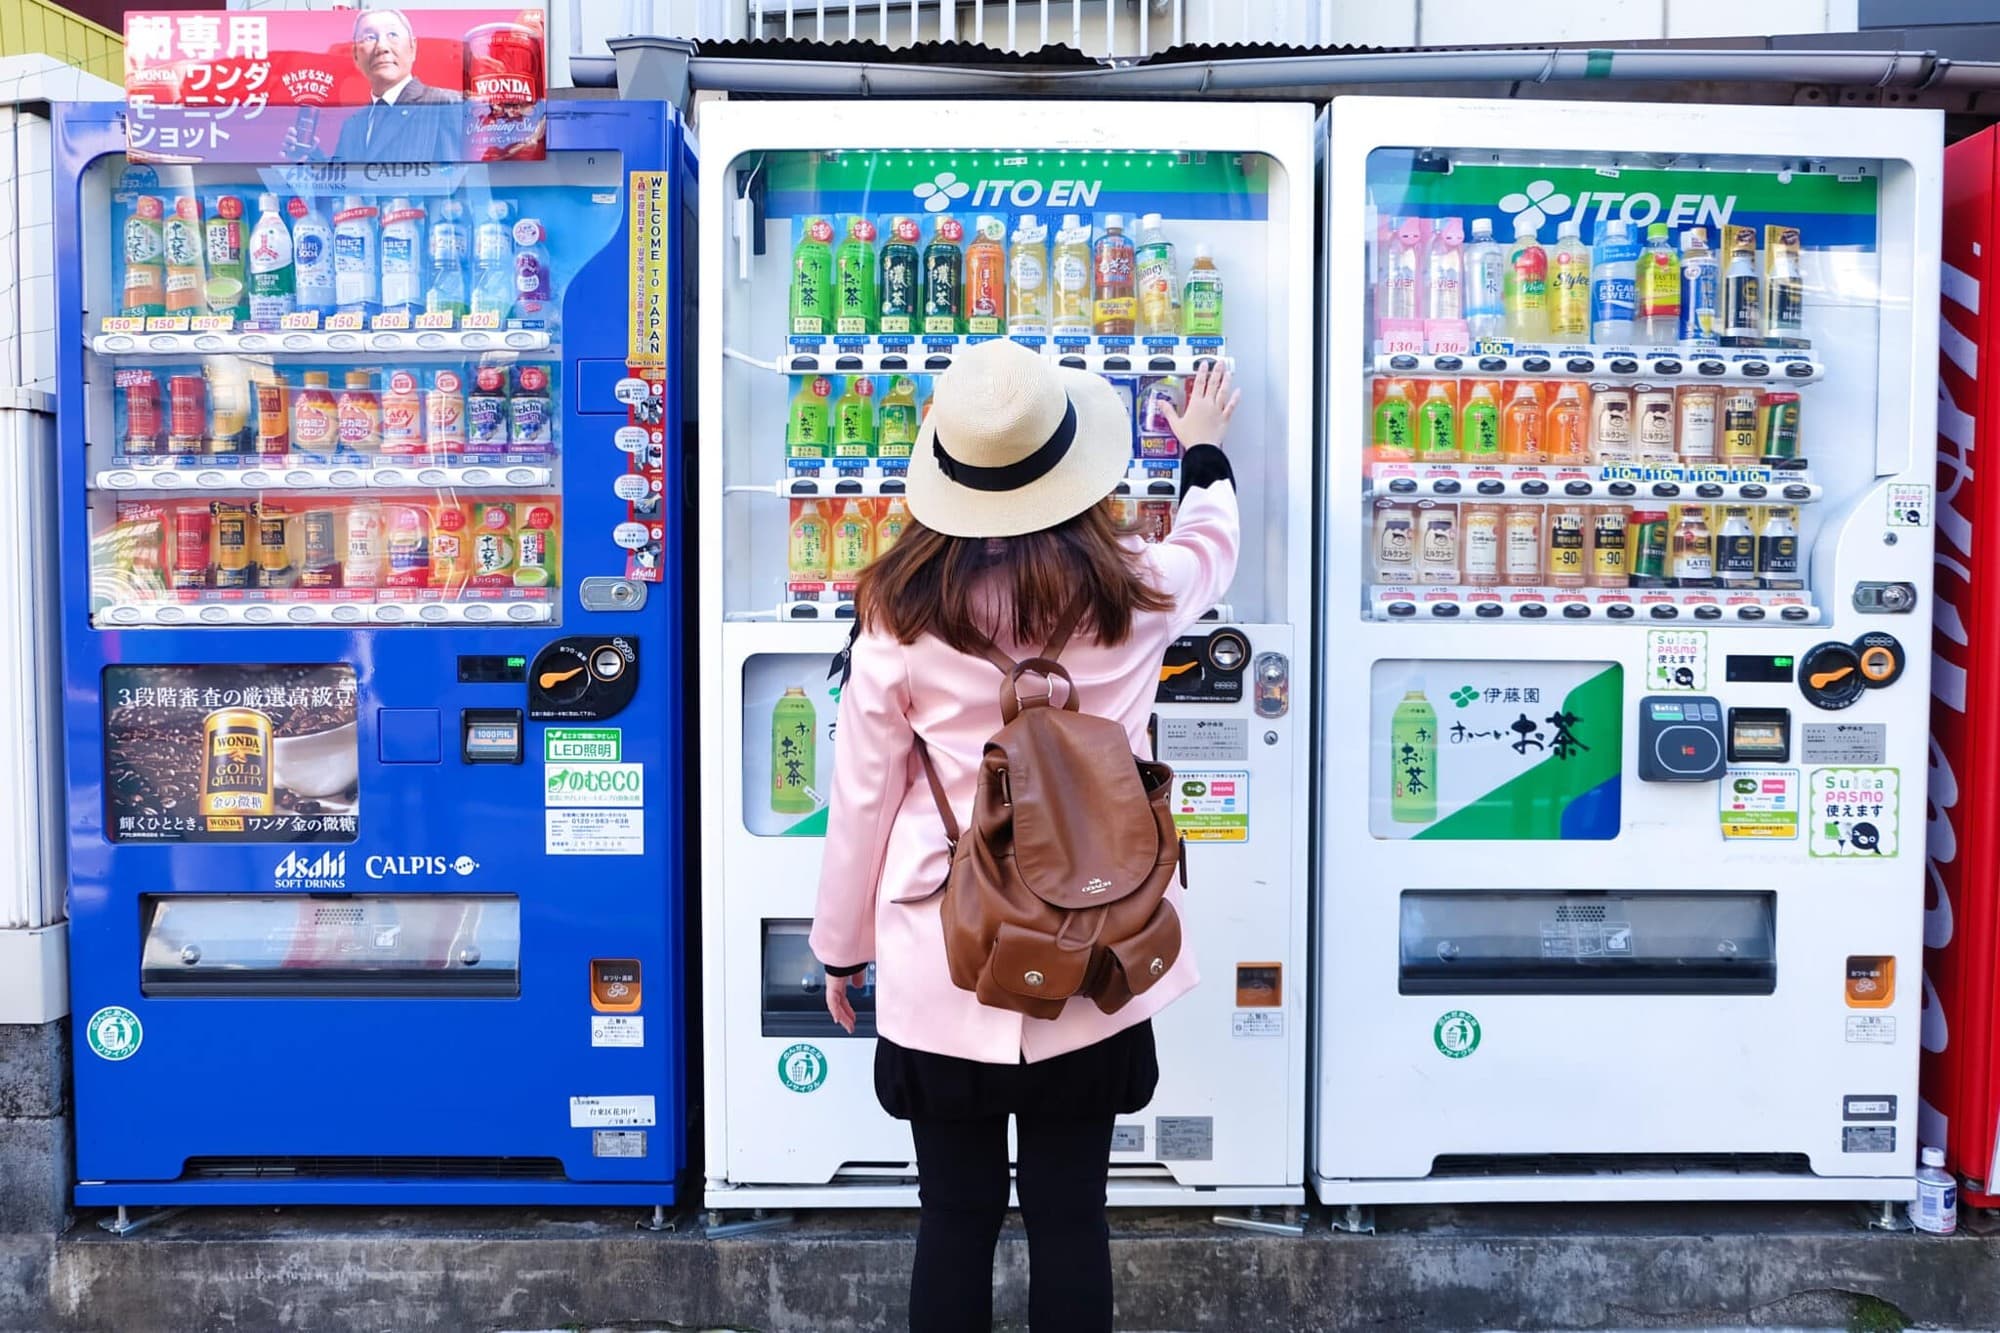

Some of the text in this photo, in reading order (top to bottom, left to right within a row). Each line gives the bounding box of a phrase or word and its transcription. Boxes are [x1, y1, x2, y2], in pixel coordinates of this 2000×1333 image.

[186, 62, 271, 90] ワンダ
[475, 78, 532, 96] WONDA
[129, 92, 269, 120] モーニング
[130, 122, 230, 148] ショット
[363, 162, 431, 182] CALPIS
[972, 180, 1102, 207] ITO EN
[650, 177, 663, 261] WELCOME
[1570, 193, 1737, 228] ITO EN
[651, 268, 661, 288] TO
[889, 262, 907, 306] 濃い茶
[933, 262, 951, 306] 濃い茶
[649, 294, 661, 354] JAPAN
[1657, 635, 1697, 645] Suica
[1657, 646, 1697, 654] PASMO
[1657, 655, 1697, 664] 使えます
[118, 686, 354, 709] 3段階審査の厳選高級豆
[1484, 687, 1540, 704] 伊藤園
[216, 735, 260, 748] WONDA
[554, 743, 612, 758] LED照明
[215, 763, 261, 776] GOLD
[781, 736, 807, 787] お茶
[1401, 743, 1429, 796] お茶
[211, 775, 265, 788] QUALITY
[569, 770, 640, 793] のむeco
[1825, 776, 1884, 789] Suica
[213, 794, 263, 809] 金の微糖
[1825, 791, 1884, 803] PASMO
[1826, 804, 1884, 817] 使えます
[119, 815, 357, 833] 輝くひととき。 WONDA ワンダ 金の微糖
[274, 850, 346, 879] Asahi
[365, 855, 447, 879] CALPIS
[274, 879, 345, 888] SOFT DRINKS
